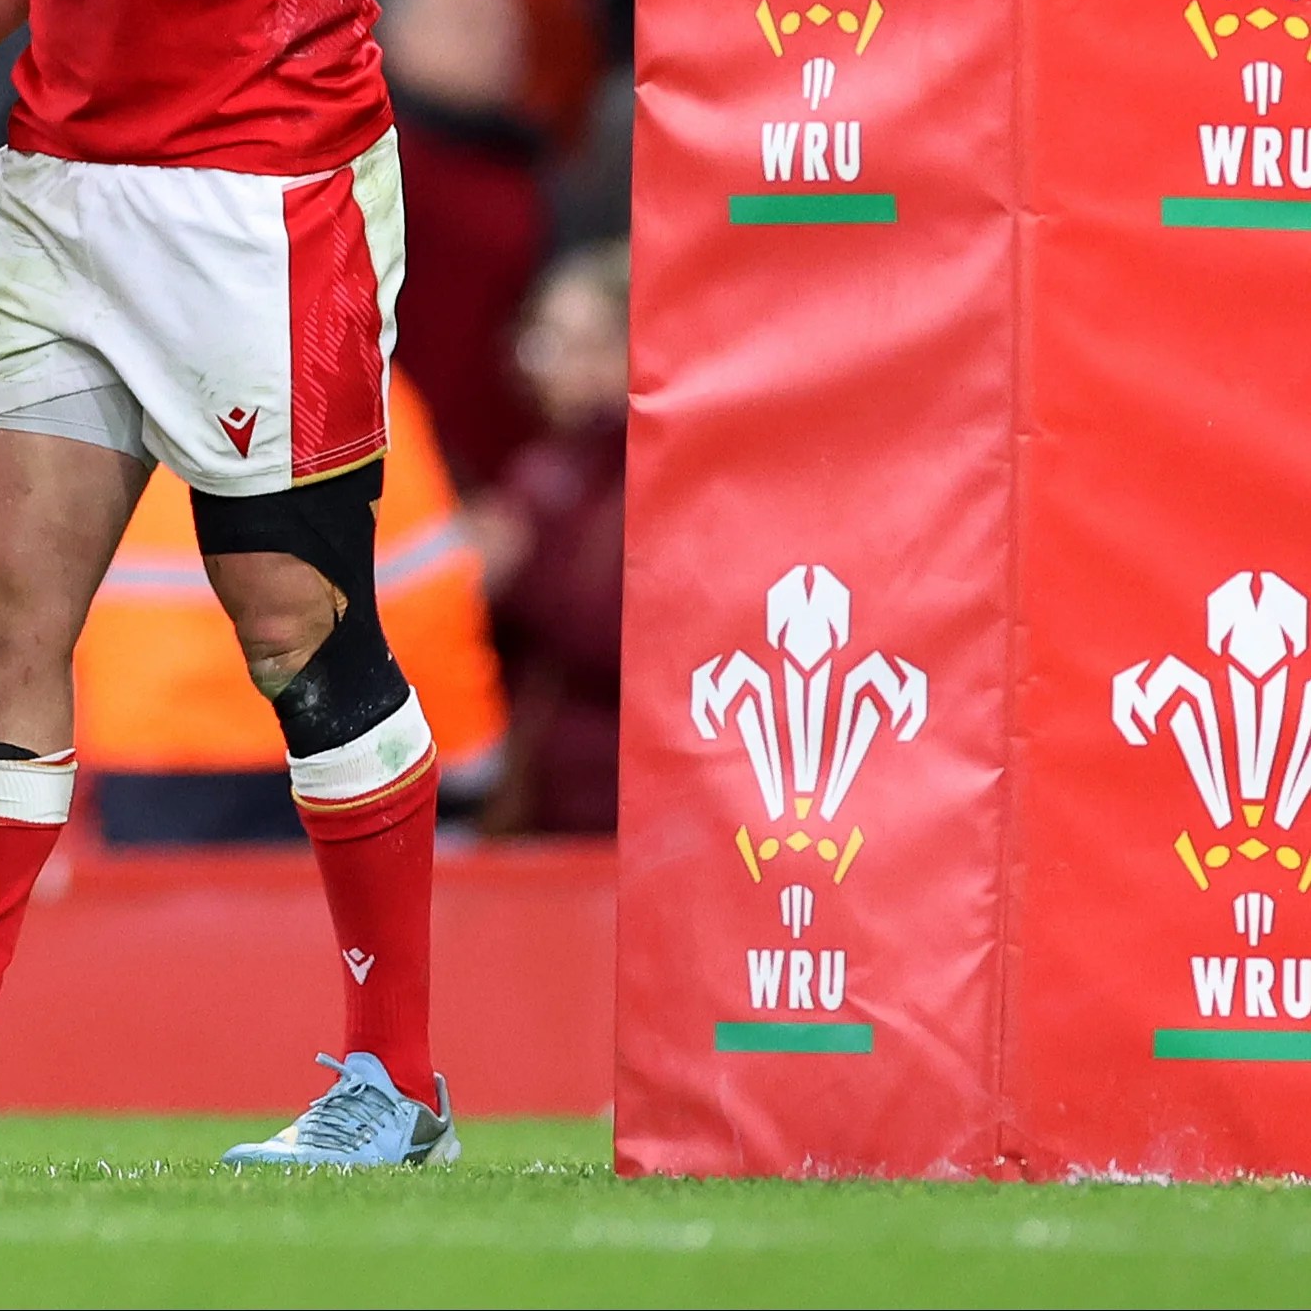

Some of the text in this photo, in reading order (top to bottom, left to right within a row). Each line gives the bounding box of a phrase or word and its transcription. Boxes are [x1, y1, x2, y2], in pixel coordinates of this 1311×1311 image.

[761, 120, 861, 182] WRU
[1198, 123, 1311, 189] WRU
[747, 948, 846, 1011] WRU
[1190, 955, 1311, 1020] WRU
